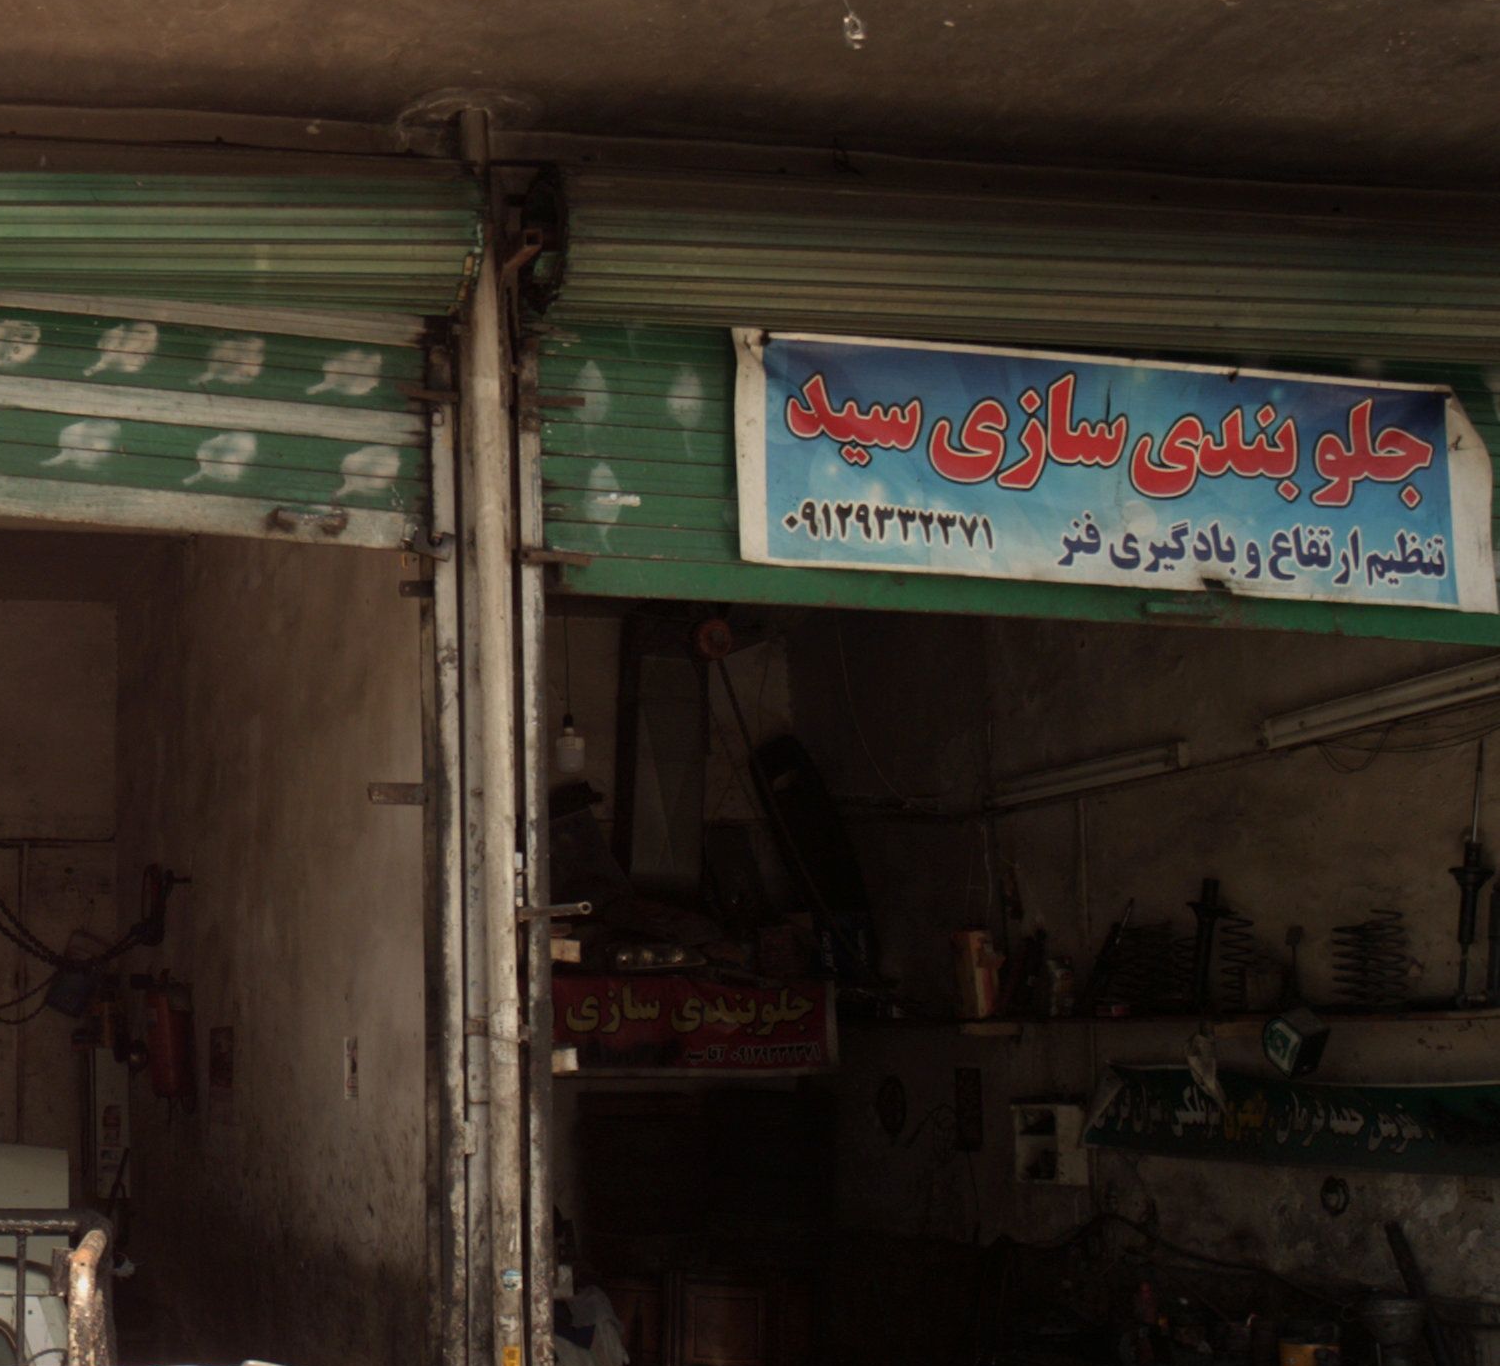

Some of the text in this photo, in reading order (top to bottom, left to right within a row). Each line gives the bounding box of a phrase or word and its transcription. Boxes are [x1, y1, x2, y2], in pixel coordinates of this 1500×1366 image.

[786, 373, 922, 467] سید
[928, 372, 1128, 490] سازی
[783, 499, 995, 552] ۰۹۱۲۹۳۳۲۳۷۱
[1057, 511, 1102, 567] فنر
[1268, 522, 1361, 585] ارتفاع
[1243, 539, 1262, 581] و
[1365, 530, 1448, 586] تنظیم
[565, 984, 815, 1036] جلوبندی سازی
